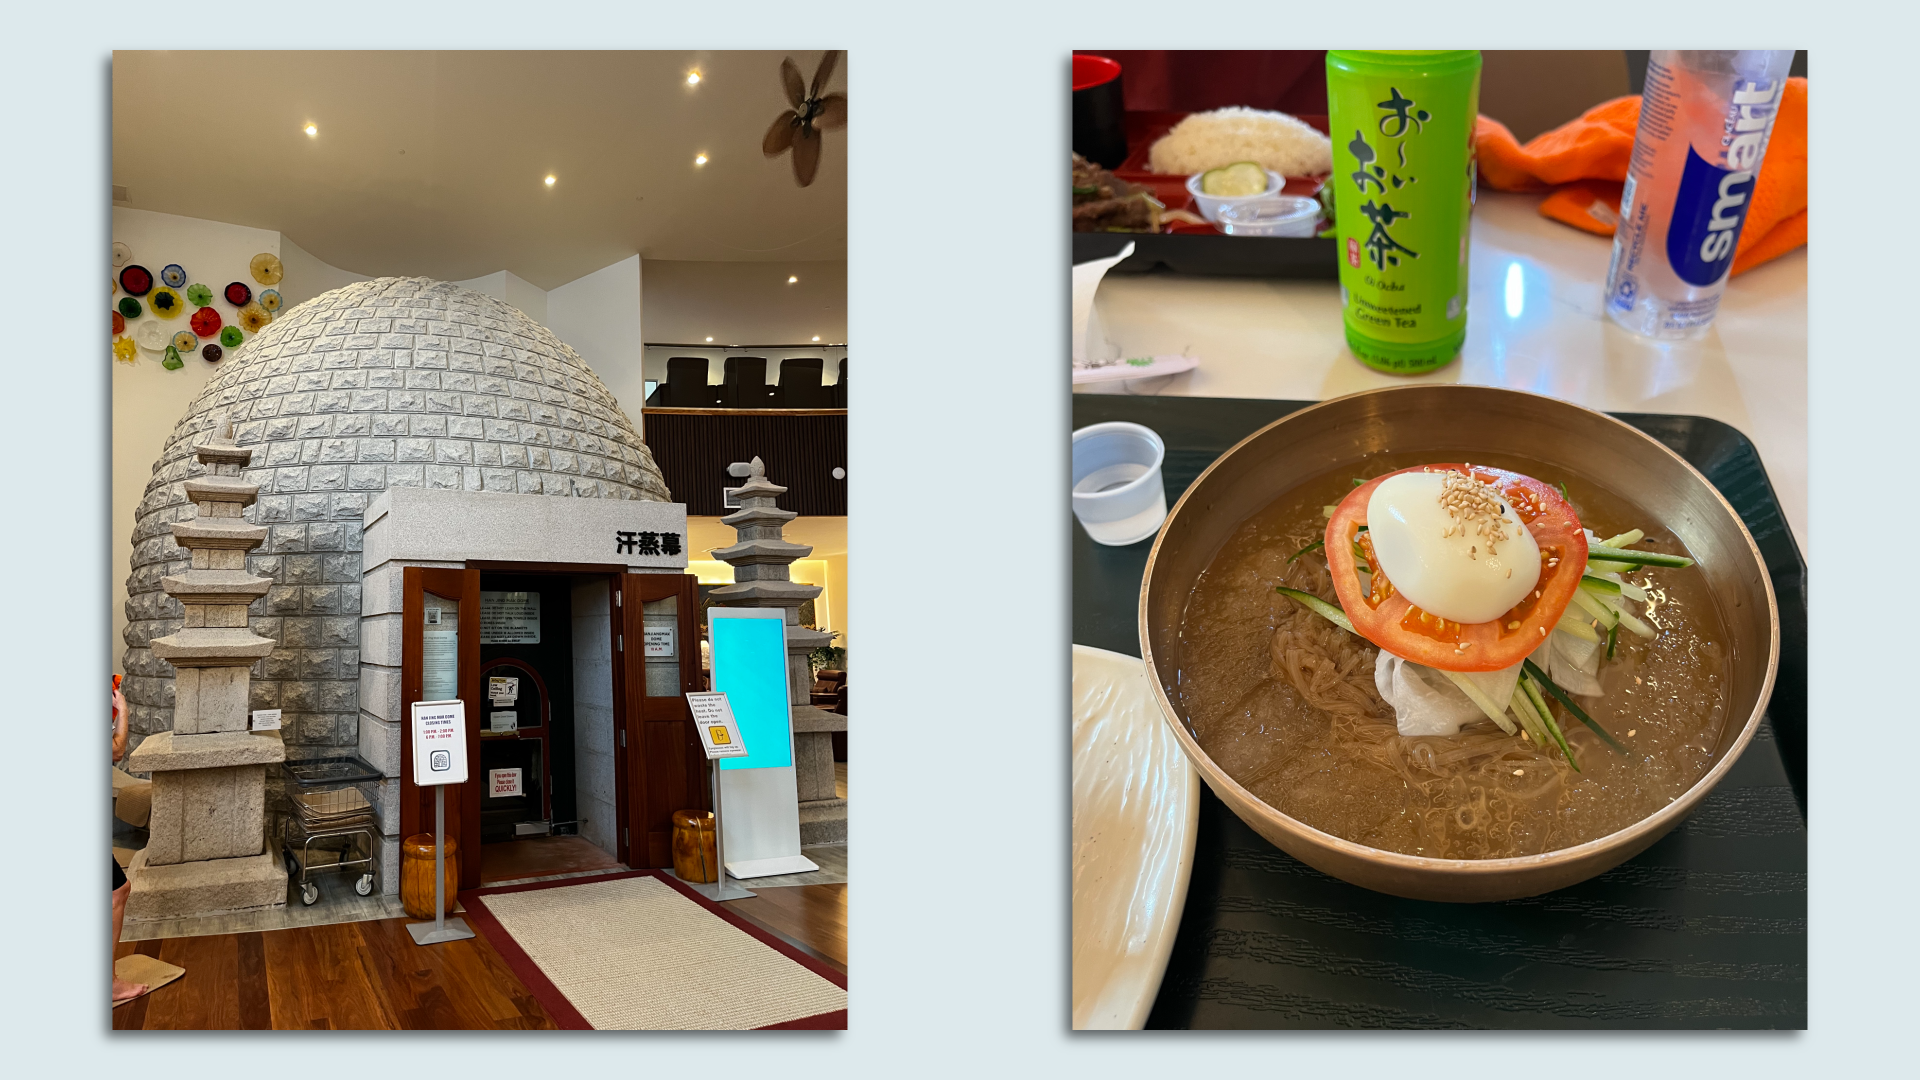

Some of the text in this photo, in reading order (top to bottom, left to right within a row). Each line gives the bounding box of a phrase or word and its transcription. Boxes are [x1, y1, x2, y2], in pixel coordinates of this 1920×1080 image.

[1700, 80, 1778, 263] smart
[1353, 293, 1423, 316] Unsweetened
[1355, 308, 1417, 328] Green Tea
[615, 530, 682, 556] 汗蒸幕
[495, 784, 517, 792] QUICKLY!
